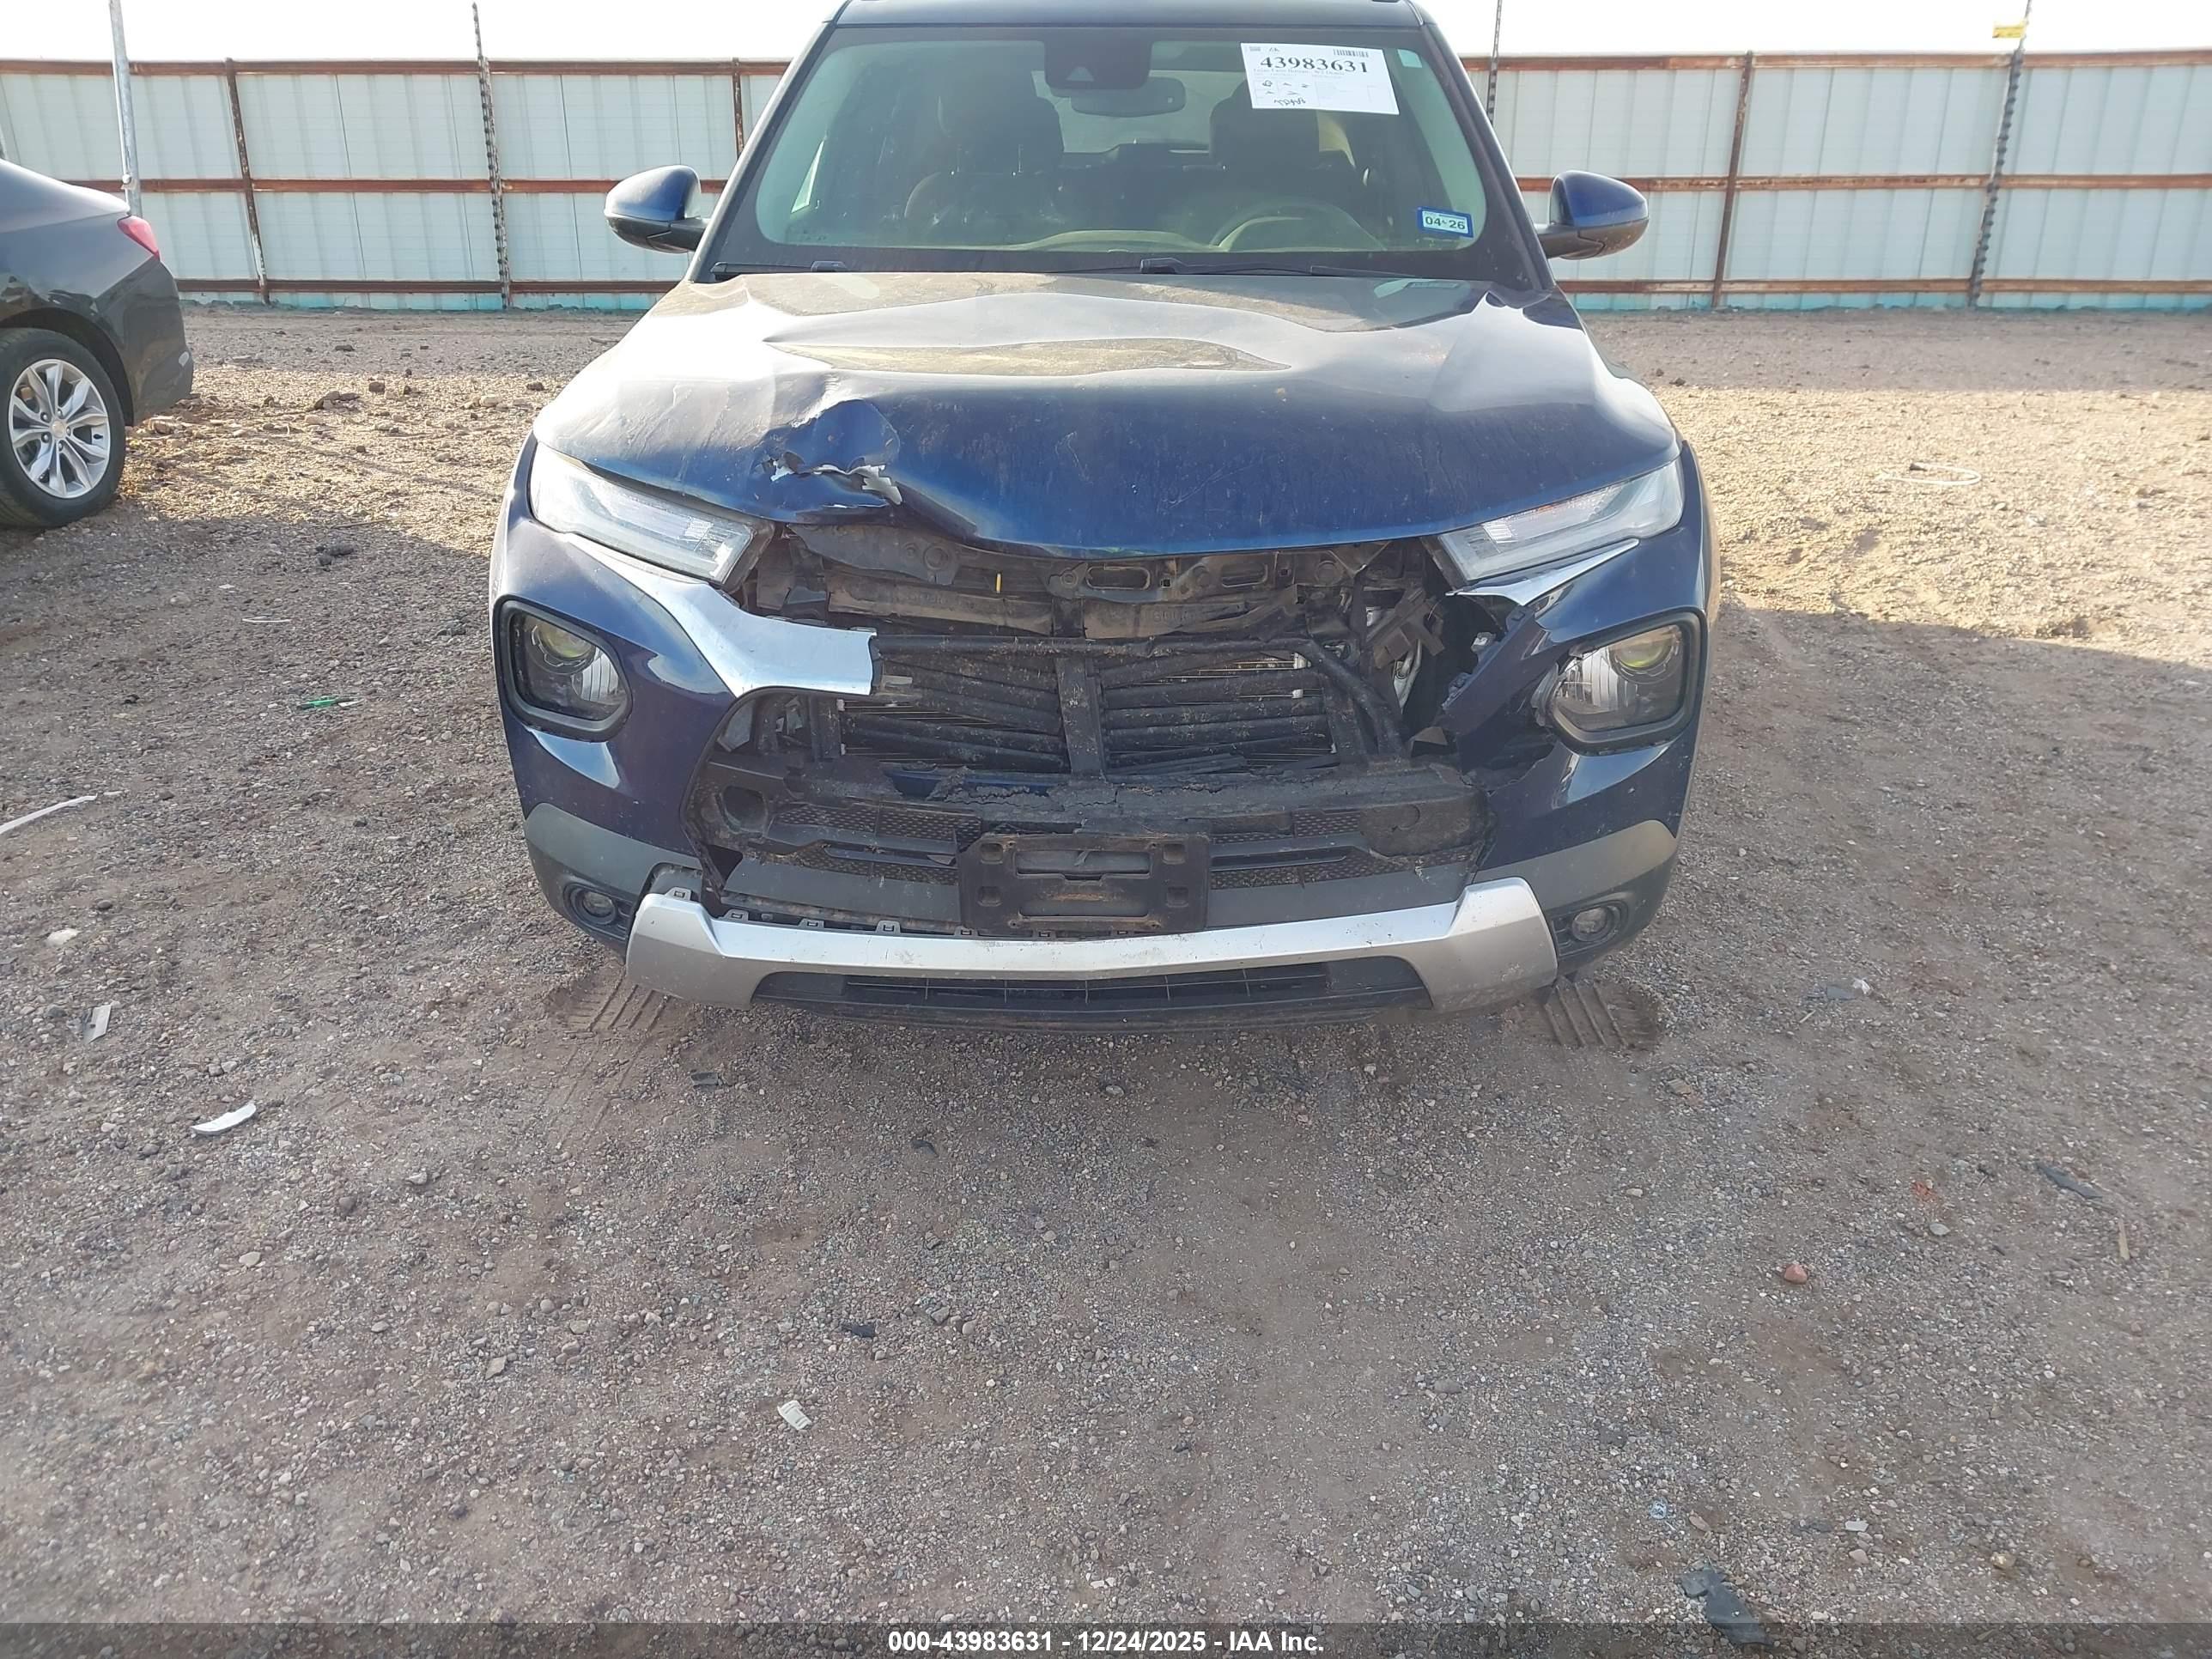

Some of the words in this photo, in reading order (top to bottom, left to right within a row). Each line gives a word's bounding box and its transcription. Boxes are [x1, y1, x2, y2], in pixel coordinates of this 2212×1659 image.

[1260, 56, 1368, 73] 43983631
[1425, 216, 1441, 227] 04
[1449, 220, 1465, 230] 26
